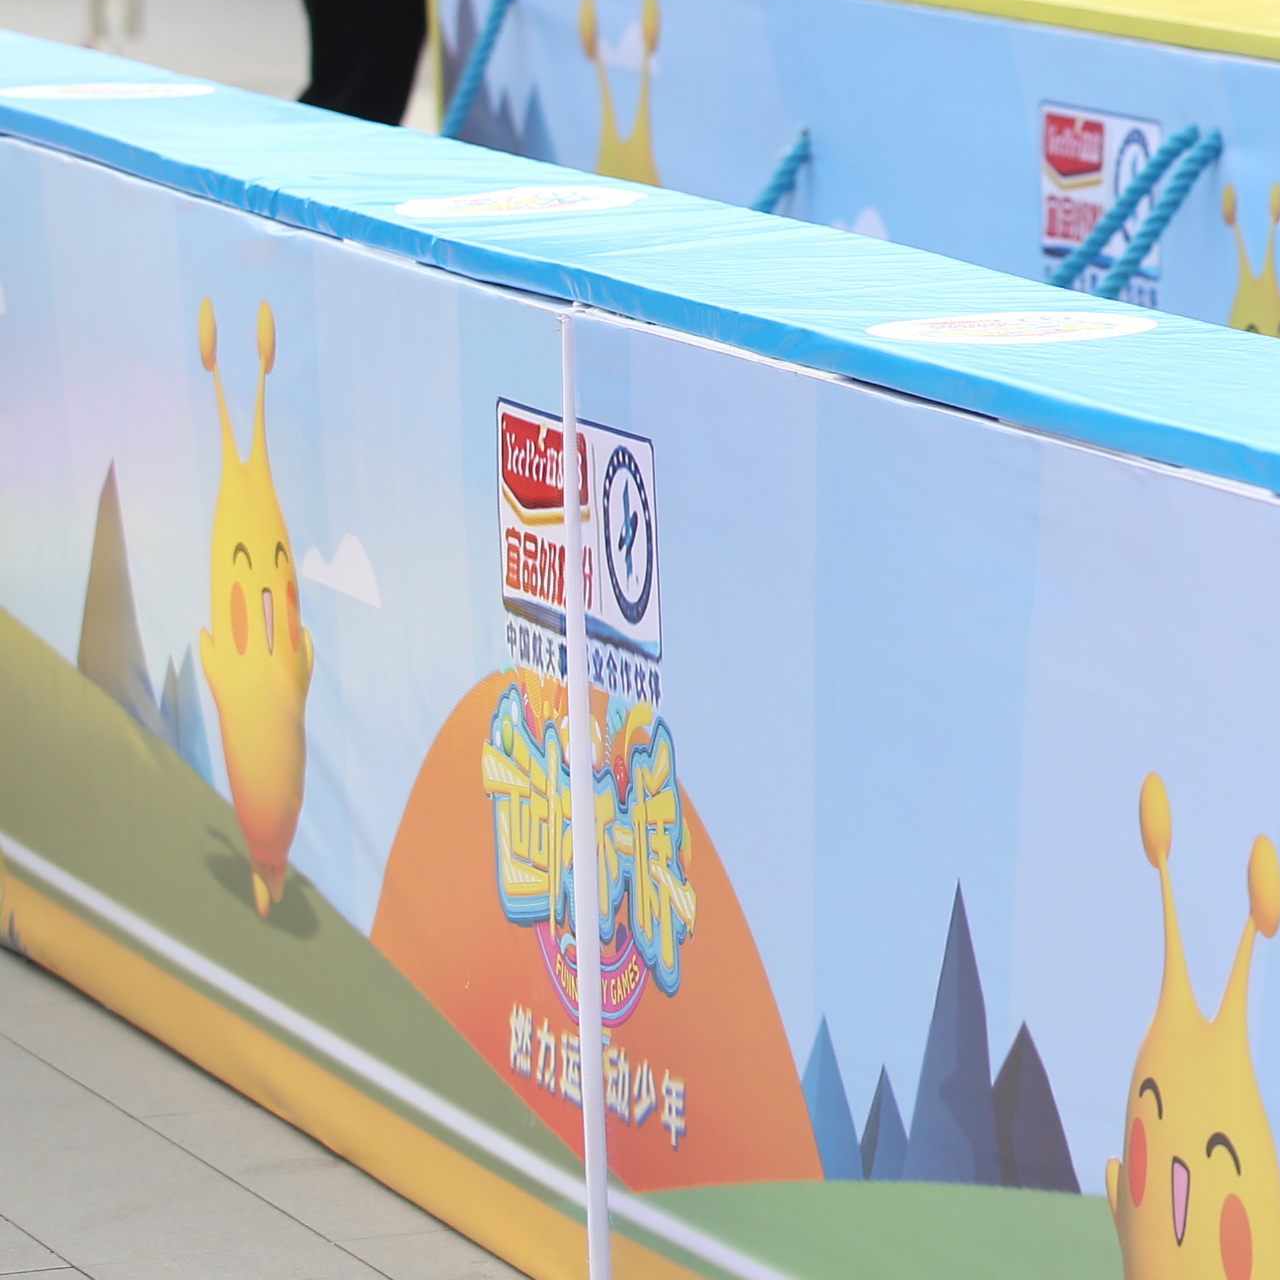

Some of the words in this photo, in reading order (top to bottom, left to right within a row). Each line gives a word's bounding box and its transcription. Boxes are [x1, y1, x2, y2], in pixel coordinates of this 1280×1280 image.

[505, 526, 593, 611] 宜品奶粉
[610, 953, 641, 1006] GAMES
[509, 999, 688, 1152] 燃力运动少年
